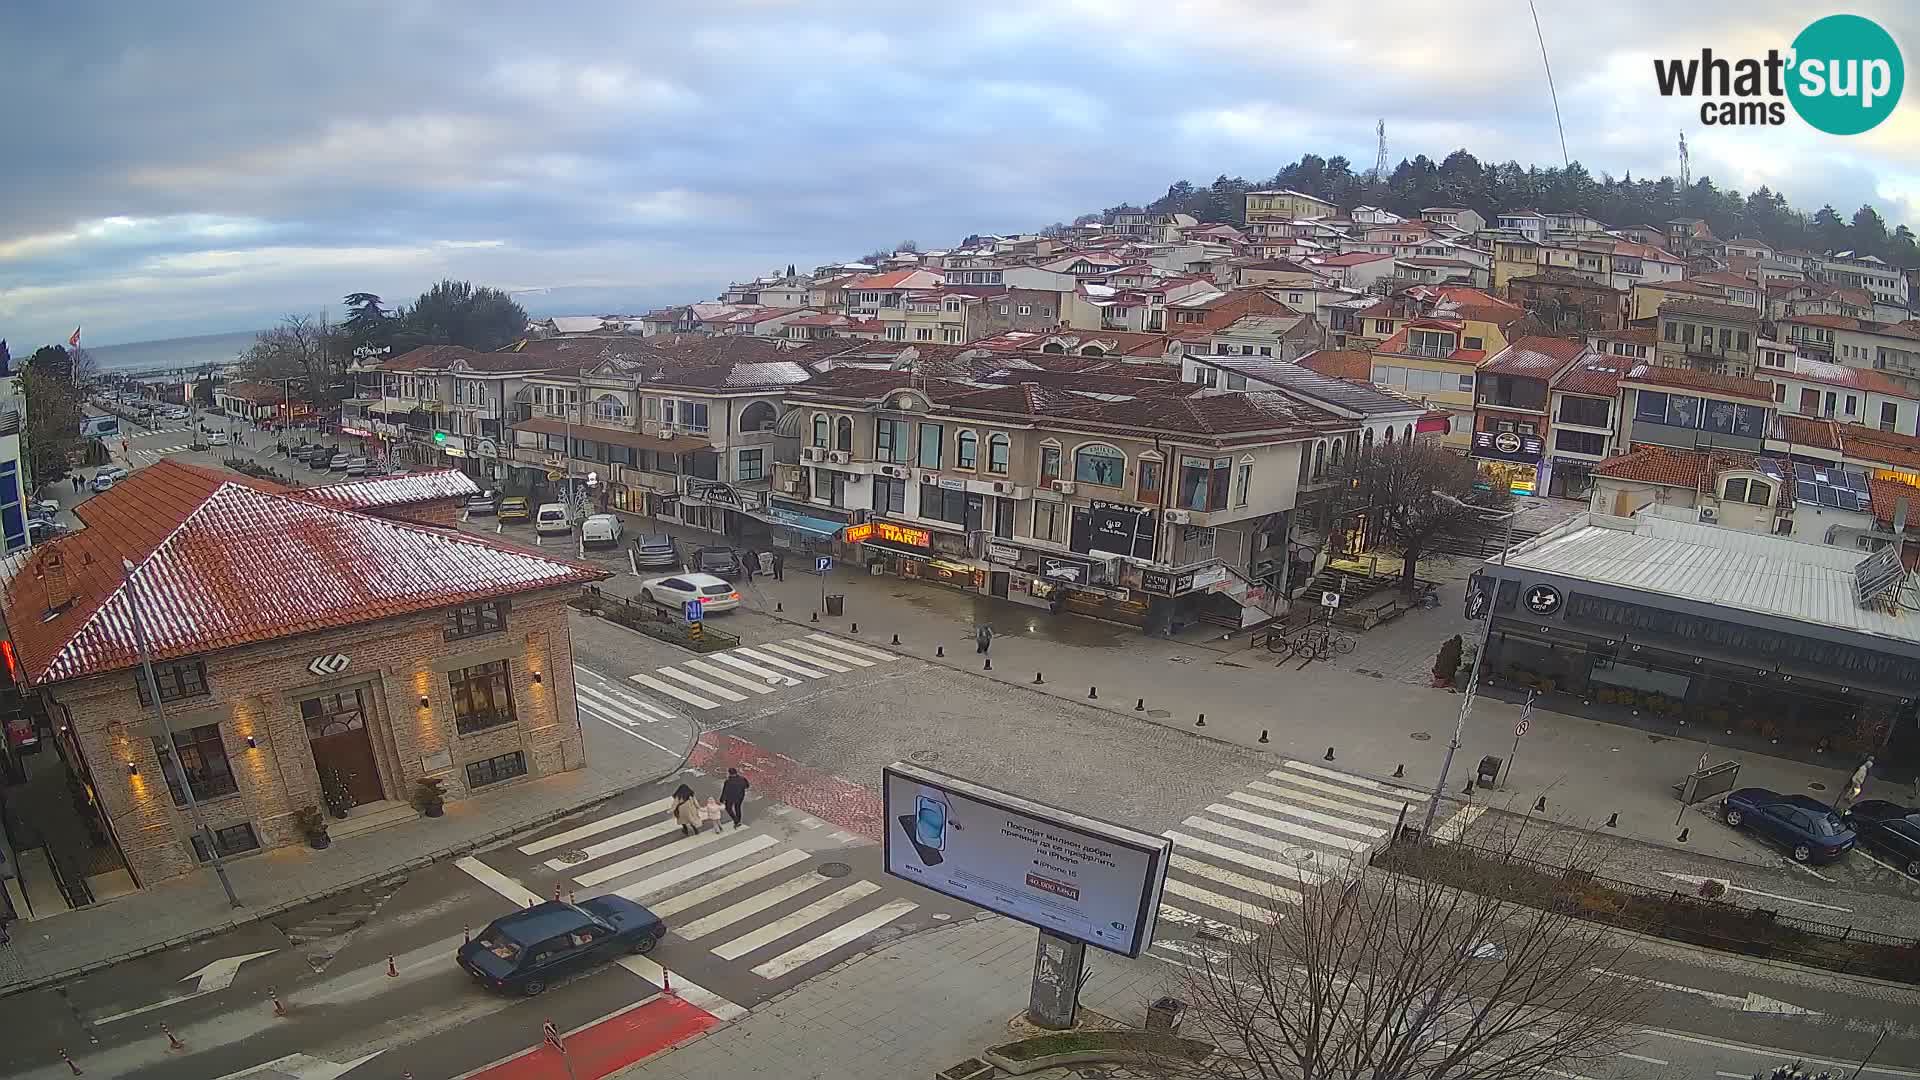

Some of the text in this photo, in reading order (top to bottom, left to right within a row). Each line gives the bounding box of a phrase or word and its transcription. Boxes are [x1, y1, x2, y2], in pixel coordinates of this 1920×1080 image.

[820, 558, 828, 569] P
[1001, 828, 1038, 845] причини
[1039, 840, 1051, 849] да
[1006, 820, 1112, 859] Постојат милион добри
[1047, 851, 1078, 865] iPhone
[1039, 861, 1067, 875] iPhone
[1068, 869, 1077, 878] 15
